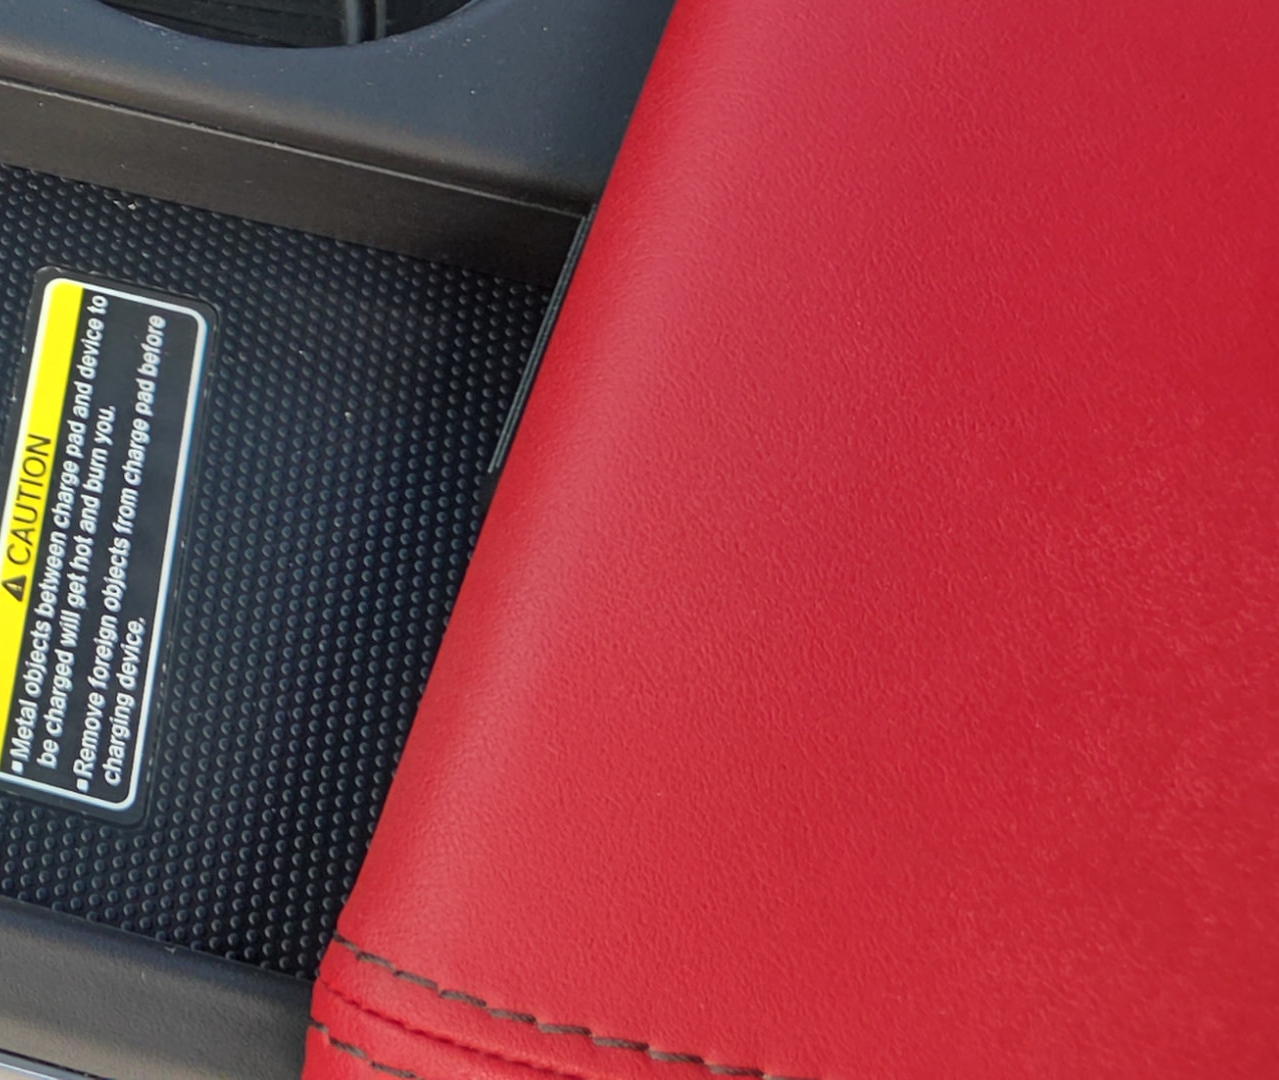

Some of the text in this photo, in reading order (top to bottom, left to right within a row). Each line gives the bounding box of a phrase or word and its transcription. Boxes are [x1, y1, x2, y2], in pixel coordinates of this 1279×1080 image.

[87, 295, 108, 316] to
[76, 317, 105, 380] device
[137, 314, 167, 377] before
[73, 381, 94, 419] and
[133, 378, 156, 416] pad
[65, 420, 87, 459] pad
[122, 417, 150, 486] charge
[51, 460, 80, 530] charge
[82, 445, 108, 494] burn
[6, 433, 52, 566] CAUTION
[79, 494, 101, 535] and
[112, 486, 139, 534] from
[34, 531, 68, 619] between
[69, 534, 94, 572] hot
[101, 537, 133, 613] objects
[66, 571, 89, 609] get
[60, 609, 82, 648] will
[87, 614, 119, 690] foreign
[23, 619, 52, 698] objects
[43, 648, 75, 737] charged
[36, 738, 59, 770] be
[102, 692, 136, 787] charging
